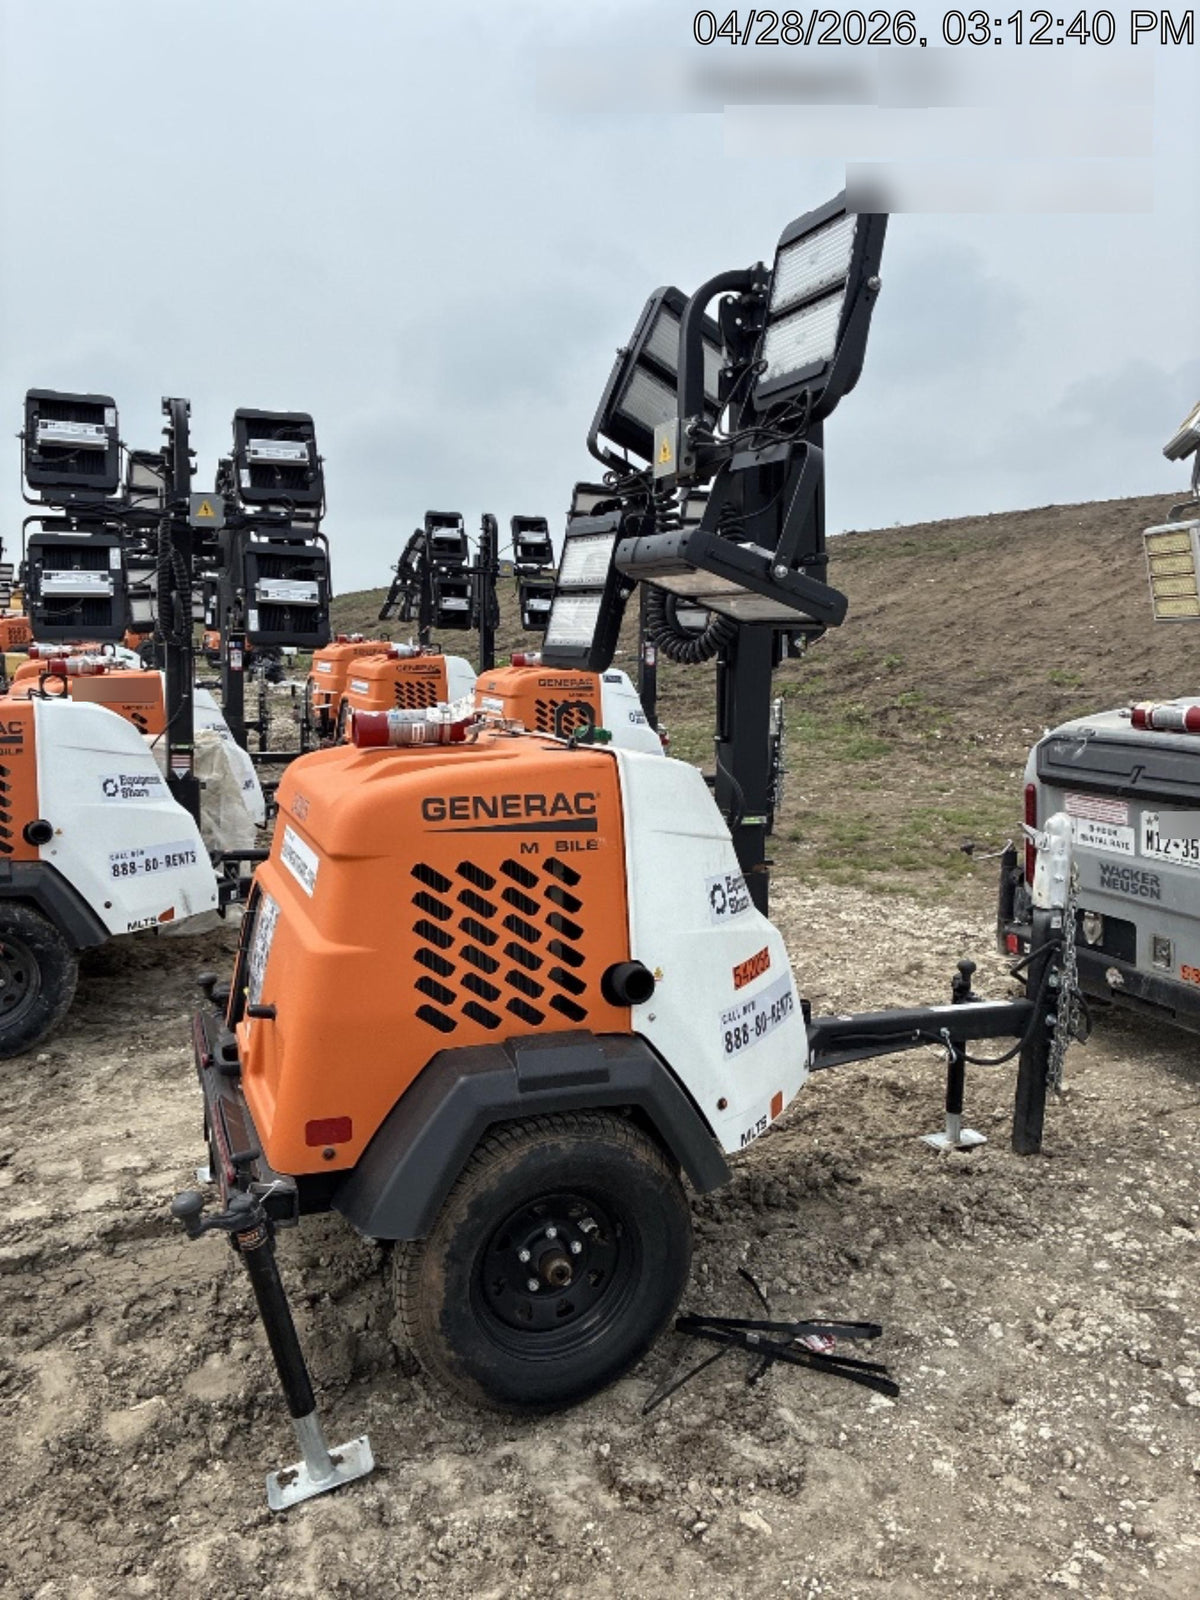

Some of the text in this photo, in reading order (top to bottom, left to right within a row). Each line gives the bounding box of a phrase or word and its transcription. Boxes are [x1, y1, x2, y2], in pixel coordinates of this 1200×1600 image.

[422, 792, 597, 822] GENERAC
[1100, 862, 1160, 888] WACKER
[1100, 875, 1160, 899] NEUSON
